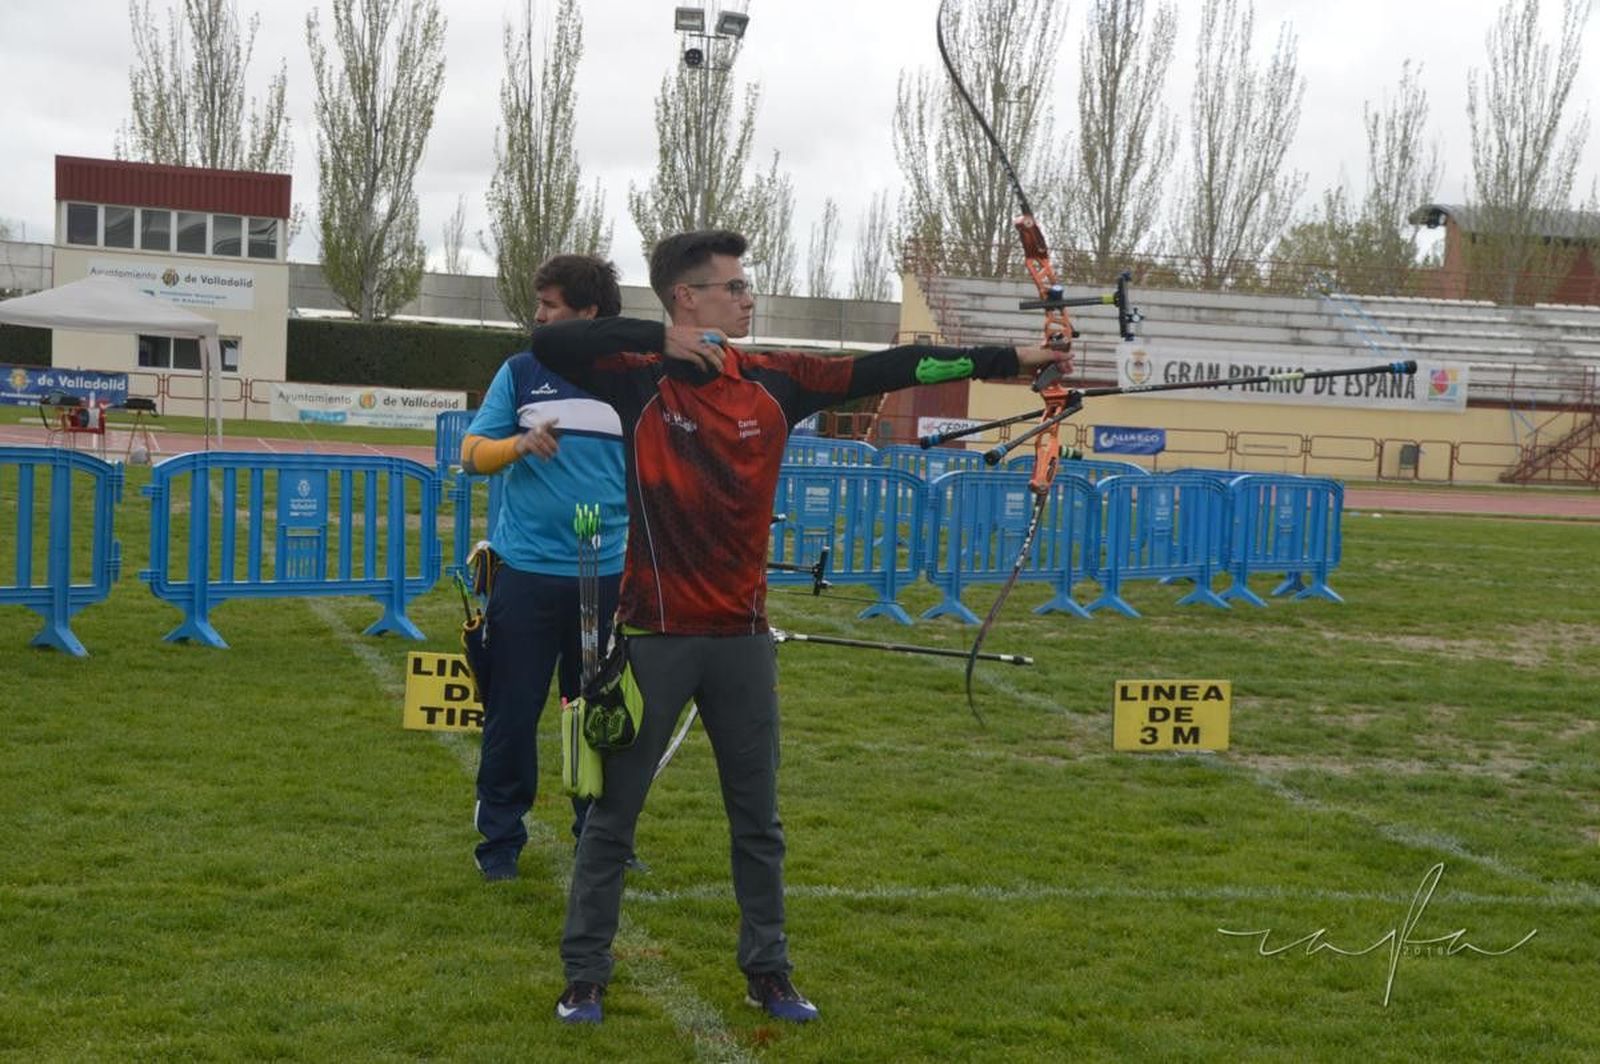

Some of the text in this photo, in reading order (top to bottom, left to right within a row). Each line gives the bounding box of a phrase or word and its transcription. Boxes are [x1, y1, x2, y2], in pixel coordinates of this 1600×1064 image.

[184, 273, 197, 283] de
[200, 275, 254, 289] Valladolid
[37, 373, 126, 391] de Valladolid
[1164, 360, 1220, 389] GRAN
[1228, 364, 1305, 395] PREMIO
[1313, 368, 1336, 395] DE
[278, 391, 459, 410] Ayuntamiento de Valladolid
[412, 657, 471, 678] LIN
[444, 684, 470, 702] D
[1120, 685, 1224, 701] LINEA
[419, 705, 485, 727] TIR
[1148, 706, 1194, 723] DE
[1139, 726, 1200, 745] 3 M
